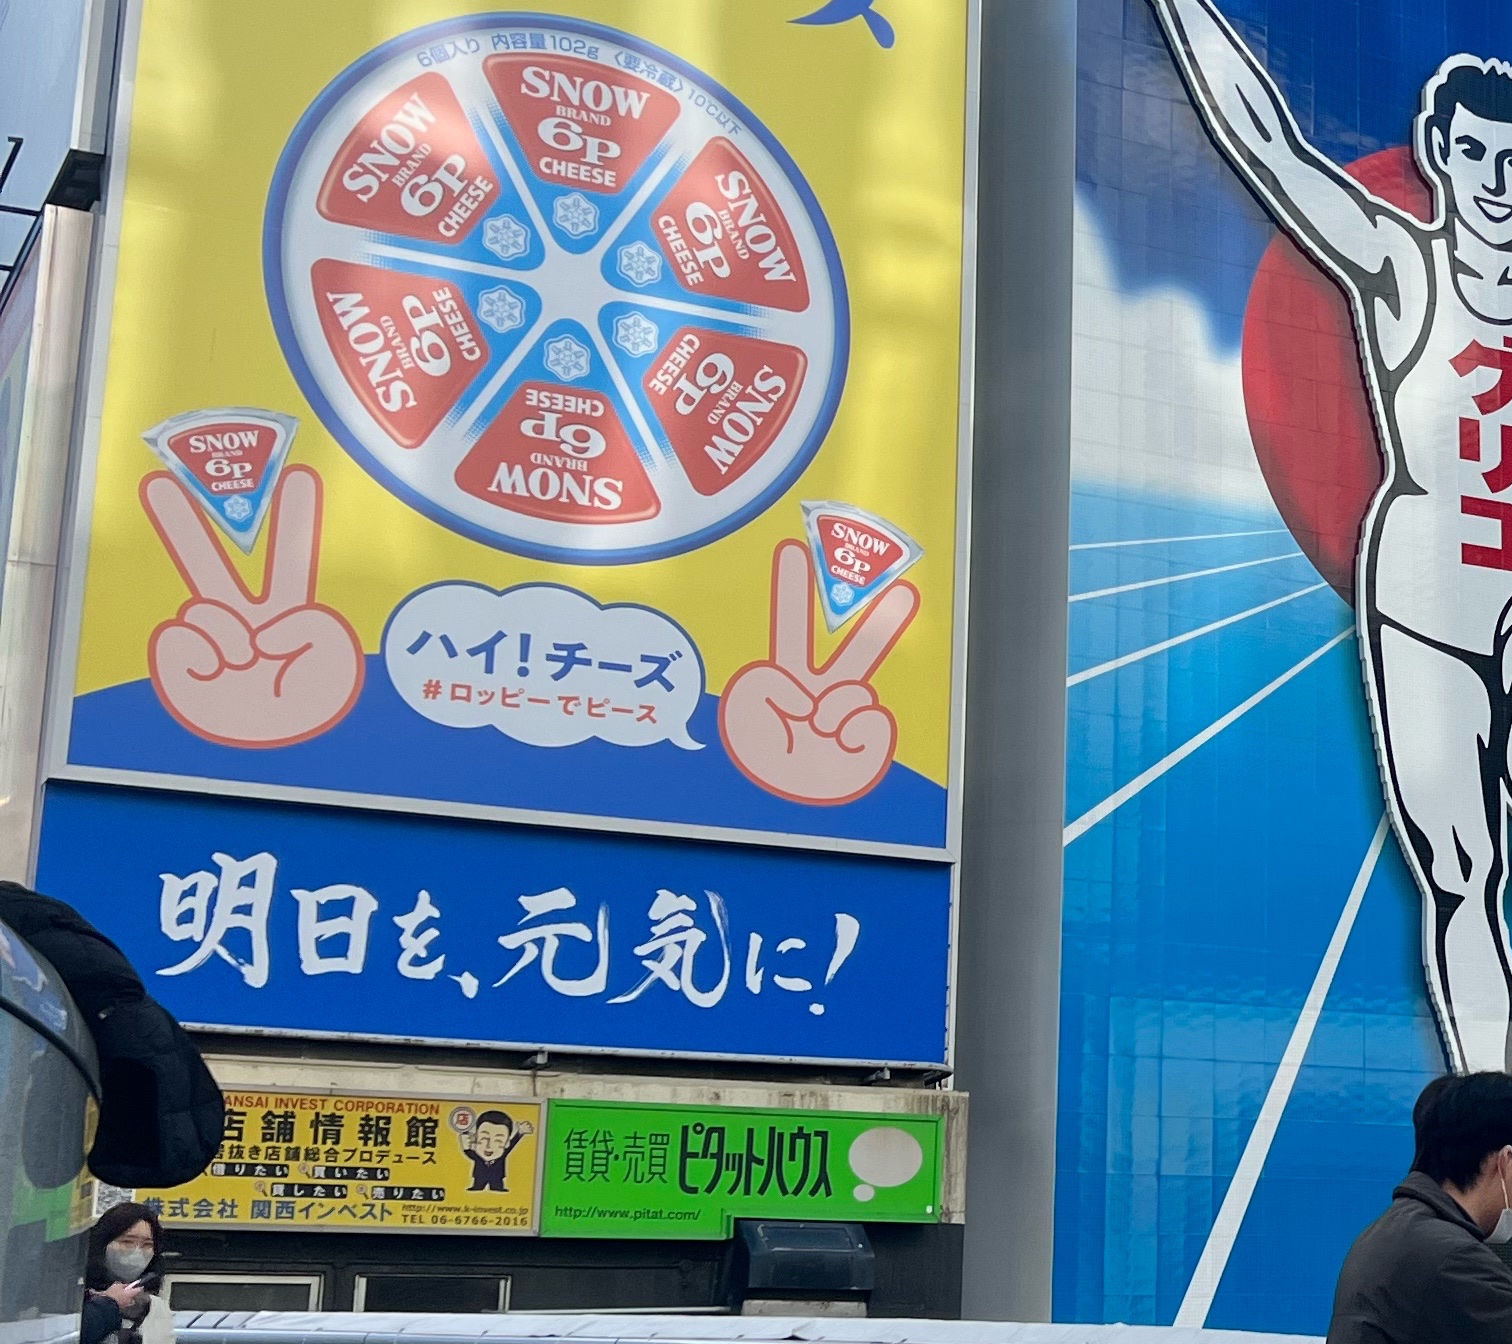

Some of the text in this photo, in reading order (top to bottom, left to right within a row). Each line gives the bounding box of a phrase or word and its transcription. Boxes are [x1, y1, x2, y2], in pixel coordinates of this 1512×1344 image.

[521, 65, 651, 119] SNOW
[342, 93, 437, 203] SNOW
[537, 116, 621, 166] 6P
[400, 154, 466, 217] 6P
[539, 157, 616, 187] CHEESE
[437, 176, 493, 238] CHEESE
[715, 171, 796, 282] SNOW
[657, 214, 703, 286] CHEESE
[685, 202, 731, 279] 6P
[402, 295, 451, 377] 6P
[432, 287, 481, 361] CHEESE
[327, 292, 417, 412] SNOW
[648, 333, 701, 395] CHEESE
[525, 389, 605, 417] CHEESE
[675, 353, 735, 415] 6P
[189, 430, 259, 453] SNOW
[520, 411, 606, 458] 6P
[704, 364, 786, 475] SNOW
[205, 458, 252, 479] 6P
[211, 478, 254, 491] CHEESE
[487, 462, 623, 510] SNOW
[831, 522, 890, 556] SNOW
[834, 547, 871, 574] 6P
[831, 565, 866, 585] CHEESE
[405, 629, 684, 692] ハイ!チーズ
[422, 679, 658, 724] #ロッピーでピース
[155, 851, 861, 1016] 明日を、元気に!
[223, 1095, 440, 1115] ANSAI INVEST CORPORATION
[679, 1122, 833, 1197] ピタットハウス
[251, 1199, 393, 1222] 関西インベスト
[402, 1214, 425, 1224] TEL
[555, 1205, 701, 1221] http://www.pitat.com/
